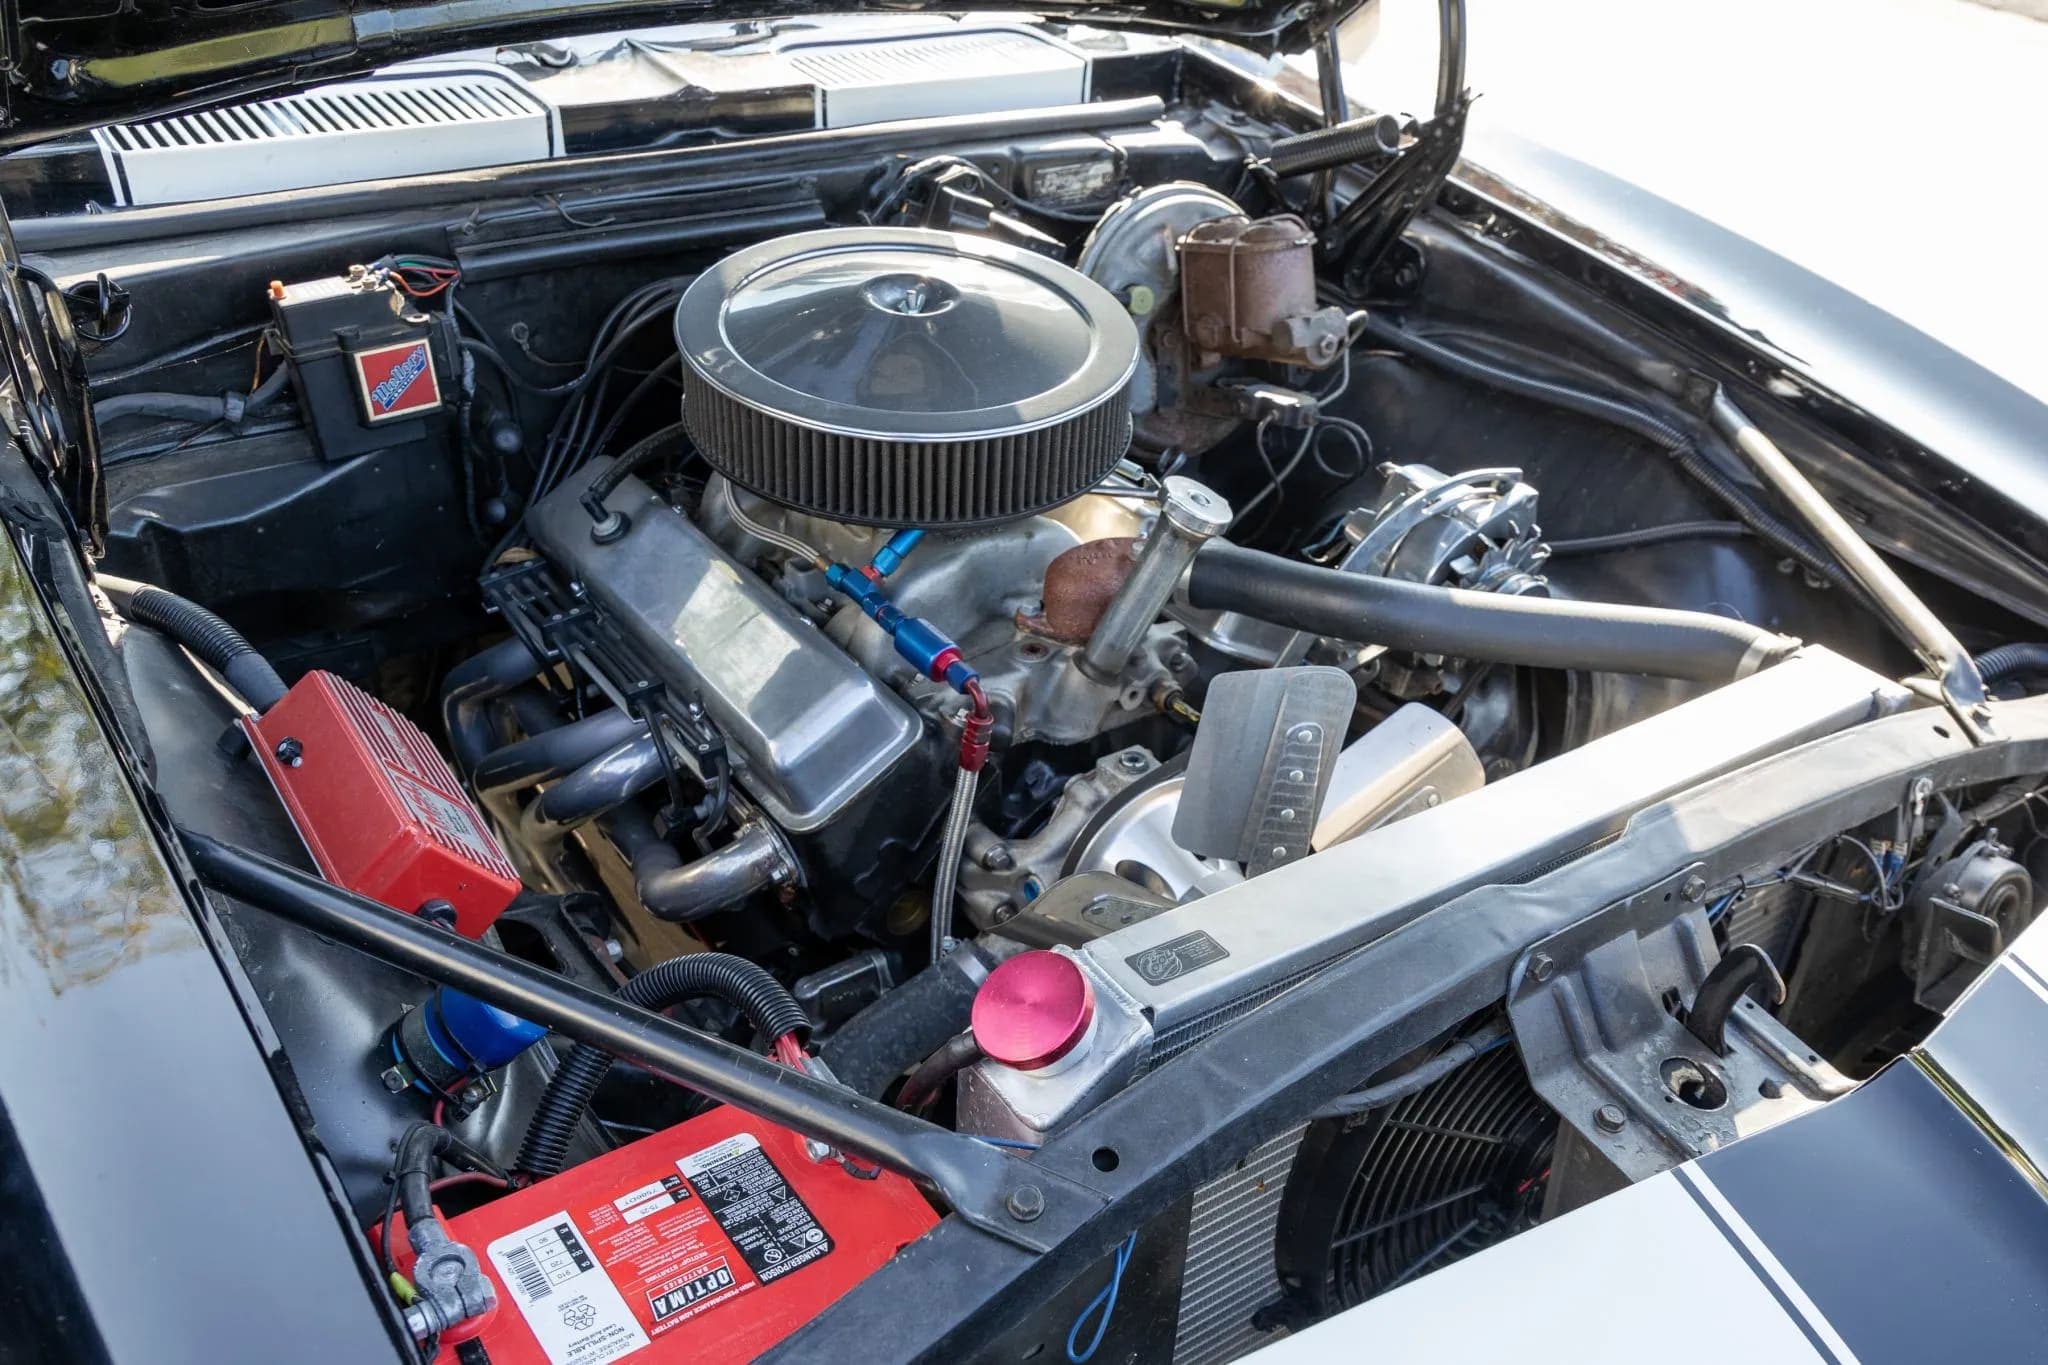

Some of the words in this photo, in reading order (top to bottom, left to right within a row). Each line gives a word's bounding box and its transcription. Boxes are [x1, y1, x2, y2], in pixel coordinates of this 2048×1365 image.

[372, 346, 425, 402] Mallory
[759, 1164, 772, 1172] GET
[695, 1178, 709, 1186] NOT
[735, 1169, 761, 1183] MEDICAL
[719, 1180, 736, 1190] HELP
[746, 1184, 763, 1195] EYES
[746, 1199, 775, 1216] SULFURIC
[791, 1205, 803, 1214] CAN
[721, 1218, 734, 1227] CAN
[733, 1212, 748, 1222] ACID
[773, 1211, 793, 1223] CAUSE
[785, 1210, 807, 1224] GASES
[776, 1215, 811, 1235] EXPLOSIVE
[793, 1220, 815, 1234] SHIELD
[537, 1236, 548, 1244] 90
[731, 1225, 759, 1241] SMOKING
[738, 1231, 763, 1245] FLAMES
[743, 1236, 767, 1251] SPARKS
[761, 1240, 775, 1250] NO
[549, 1258, 563, 1268] 720
[759, 1246, 820, 1282] DANGER/POISON
[556, 1269, 571, 1279] 910
[643, 1263, 679, 1283] STARTING
[661, 1265, 709, 1291] BATTERIES
[652, 1267, 732, 1315] OPTIMA
[692, 1279, 755, 1314] HIGH-PERFORMANCE
[678, 1309, 694, 1320] AGM
[601, 1322, 617, 1333] Lead
[648, 1316, 679, 1335] BATTERY
[566, 1325, 625, 1357] NON-SPILLABLE
[588, 1329, 602, 1339] Acid
[567, 1335, 589, 1349] Battery
